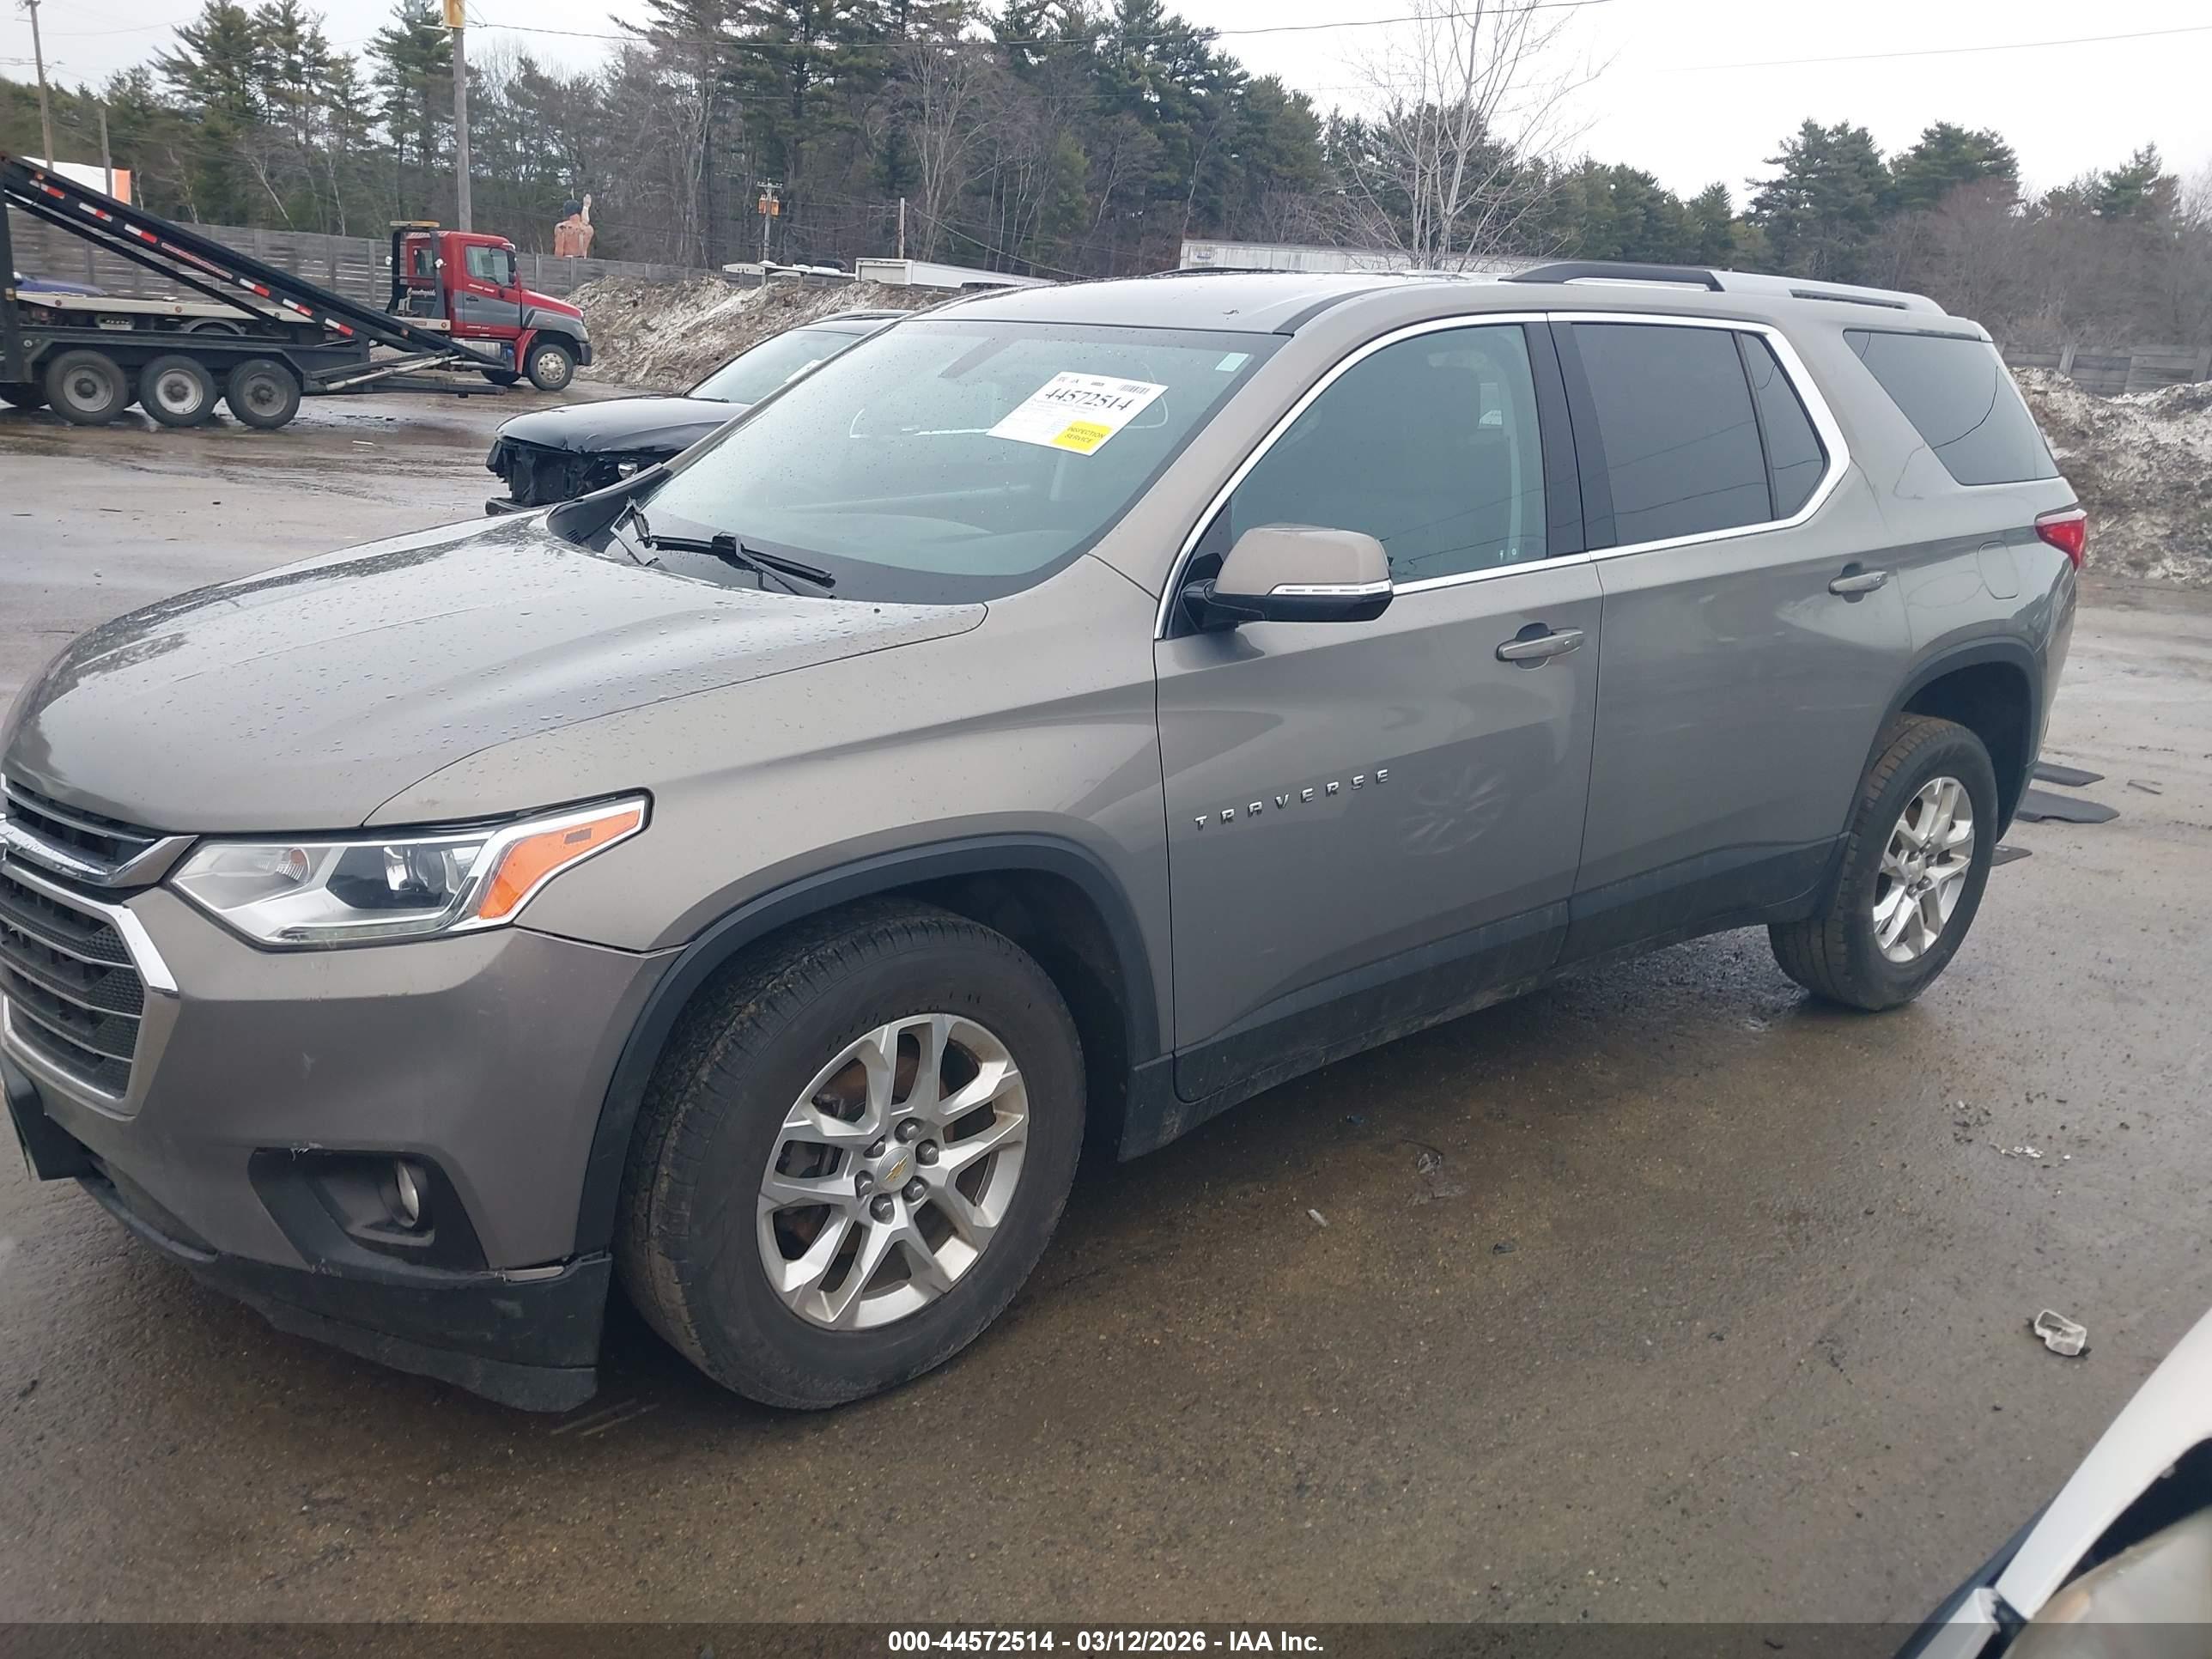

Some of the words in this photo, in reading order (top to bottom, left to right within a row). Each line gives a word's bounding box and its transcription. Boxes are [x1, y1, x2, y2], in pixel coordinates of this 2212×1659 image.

[1045, 387, 1134, 410] 44572514
[1064, 433, 1093, 444] SERVICE
[1067, 426, 1107, 439] INSPECTION
[1194, 769, 1389, 830] TRAVERSE
